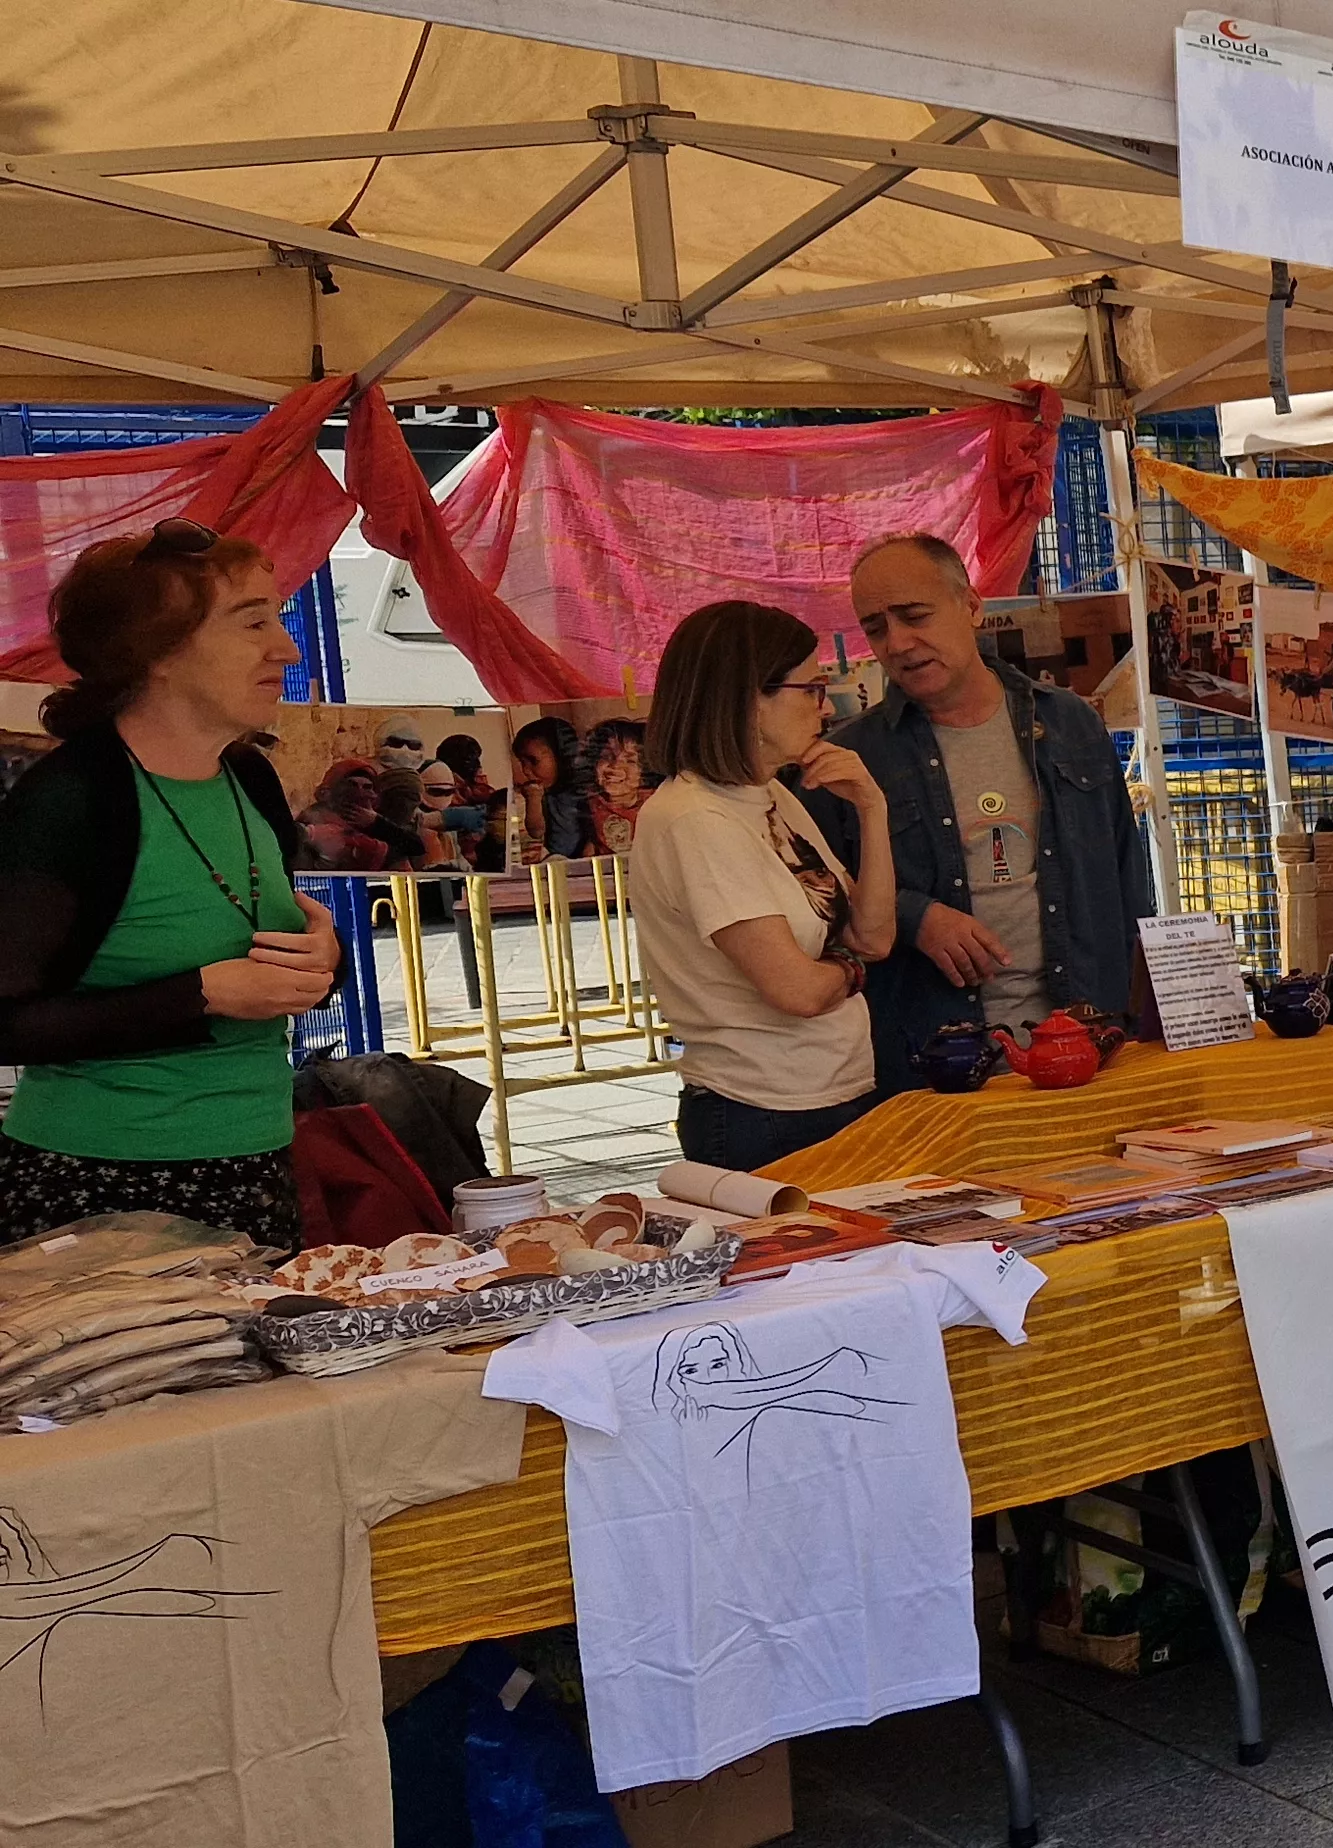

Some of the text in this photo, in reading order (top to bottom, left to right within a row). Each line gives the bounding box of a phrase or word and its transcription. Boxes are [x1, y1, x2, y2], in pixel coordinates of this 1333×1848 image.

[1200, 33, 1269, 58] alouda
[1241, 145, 1323, 172] ASOCIACIÓN
[1145, 916, 1209, 929] LA CEREMONIA
[1166, 932, 1182, 941] DEL
